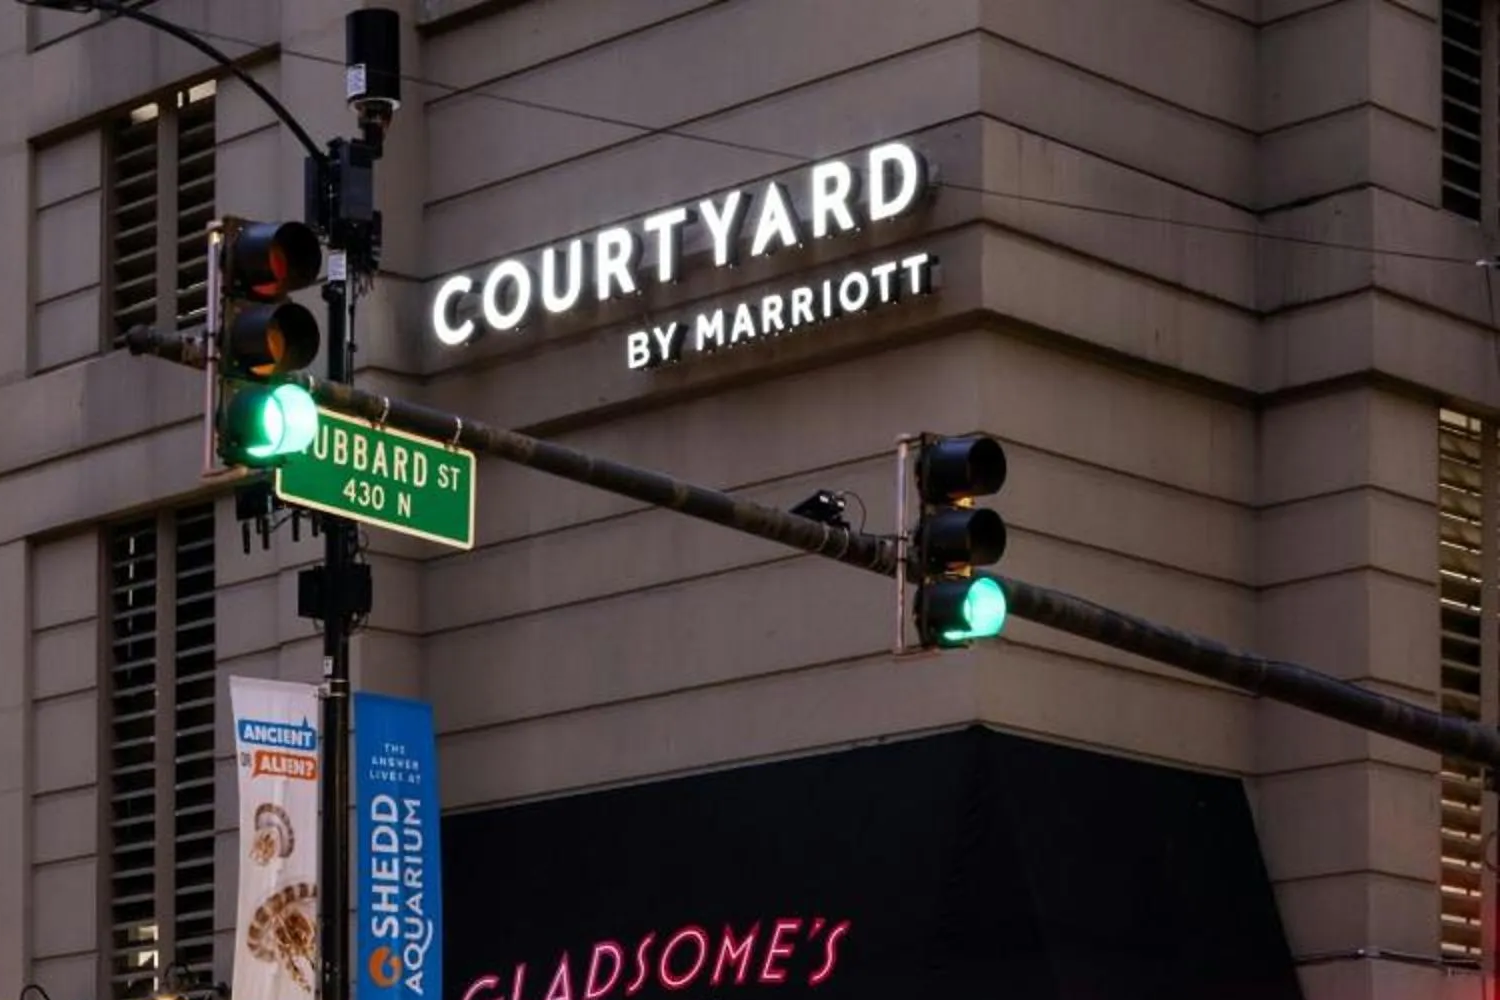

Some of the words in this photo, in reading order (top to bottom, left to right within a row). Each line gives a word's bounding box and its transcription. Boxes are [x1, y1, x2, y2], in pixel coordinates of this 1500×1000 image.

[432, 142, 919, 345] COURTYARD
[627, 323, 678, 368] BY
[696, 253, 930, 350] MARRIOTT
[303, 425, 427, 487] UBBARD
[438, 464, 460, 491] ST
[343, 479, 385, 510] 430
[397, 493, 411, 518] N
[243, 724, 313, 747] ANCIENT
[260, 755, 314, 778] ALIEN?
[371, 794, 400, 938] SHEDD
[403, 798, 433, 996] AQUARIUM
